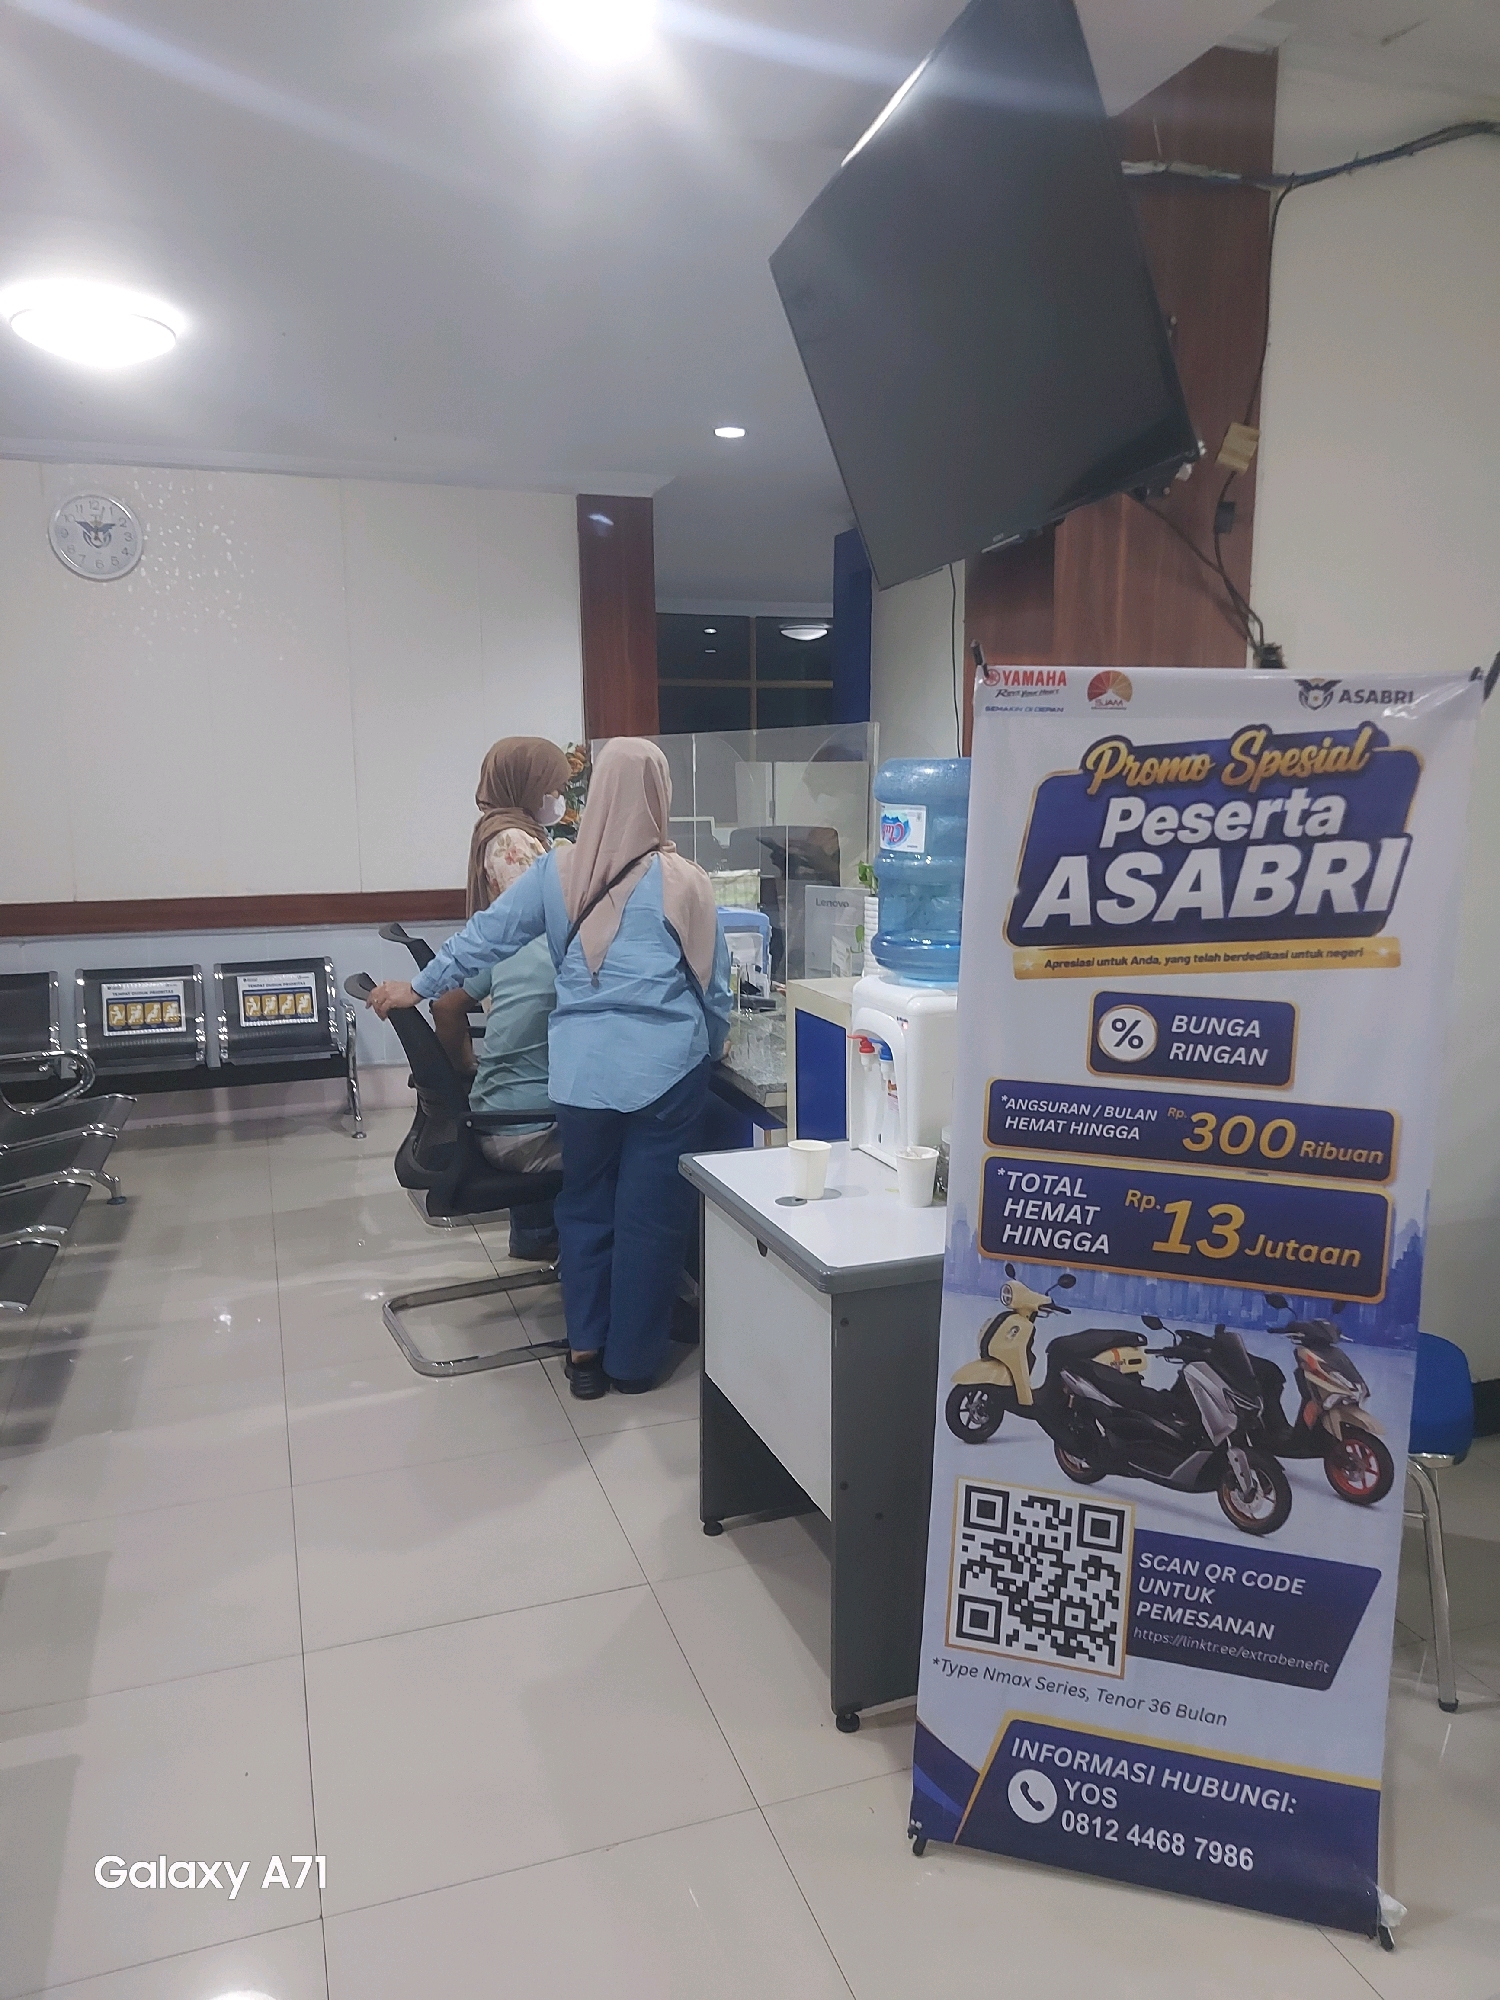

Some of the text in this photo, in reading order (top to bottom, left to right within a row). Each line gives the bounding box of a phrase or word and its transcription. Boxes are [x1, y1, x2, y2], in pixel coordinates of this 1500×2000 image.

[1002, 669, 1067, 687] YAMAHA
[1338, 689, 1414, 704] ASABRI
[1085, 726, 1373, 796] Promo Spesial
[1100, 788, 1347, 849] Peserta
[1022, 836, 1411, 929] ASABRI
[815, 898, 850, 908] Lenovo
[1044, 947, 1364, 971] Apresiasi untuk Anda, yang telah berdedikasi untuk negeri
[1171, 1014, 1261, 1039] BUNGA
[1168, 1042, 1268, 1067] RINGAN
[1005, 1116, 1140, 1141] HEMAT HINGGA
[1103, 1106, 1158, 1121] BULAN
[1167, 1107, 1385, 1165] Rp. 300 Ribuan
[1002, 1197, 1100, 1226] HEMAT
[1001, 1224, 1110, 1255] HINGGA
[1124, 1189, 1362, 1269] Rp. 13 Jutaan
[1138, 1552, 1306, 1595] SCAN QR CODE
[1138, 1576, 1216, 1604] UNTUK
[1136, 1600, 1275, 1640] PEMESANAN
[983, 1666, 1030, 1688] Nmax
[1034, 1676, 1090, 1701] Series,
[1096, 1687, 1145, 1711] Tenor
[1148, 1698, 1171, 1716] 36
[1175, 1703, 1227, 1727] Bulan
[1011, 1737, 1297, 1815] INFORMASI HUBUNGI:
[1063, 1778, 1118, 1809] YOS
[1061, 1809, 1254, 1871] 0812 4468 7986
